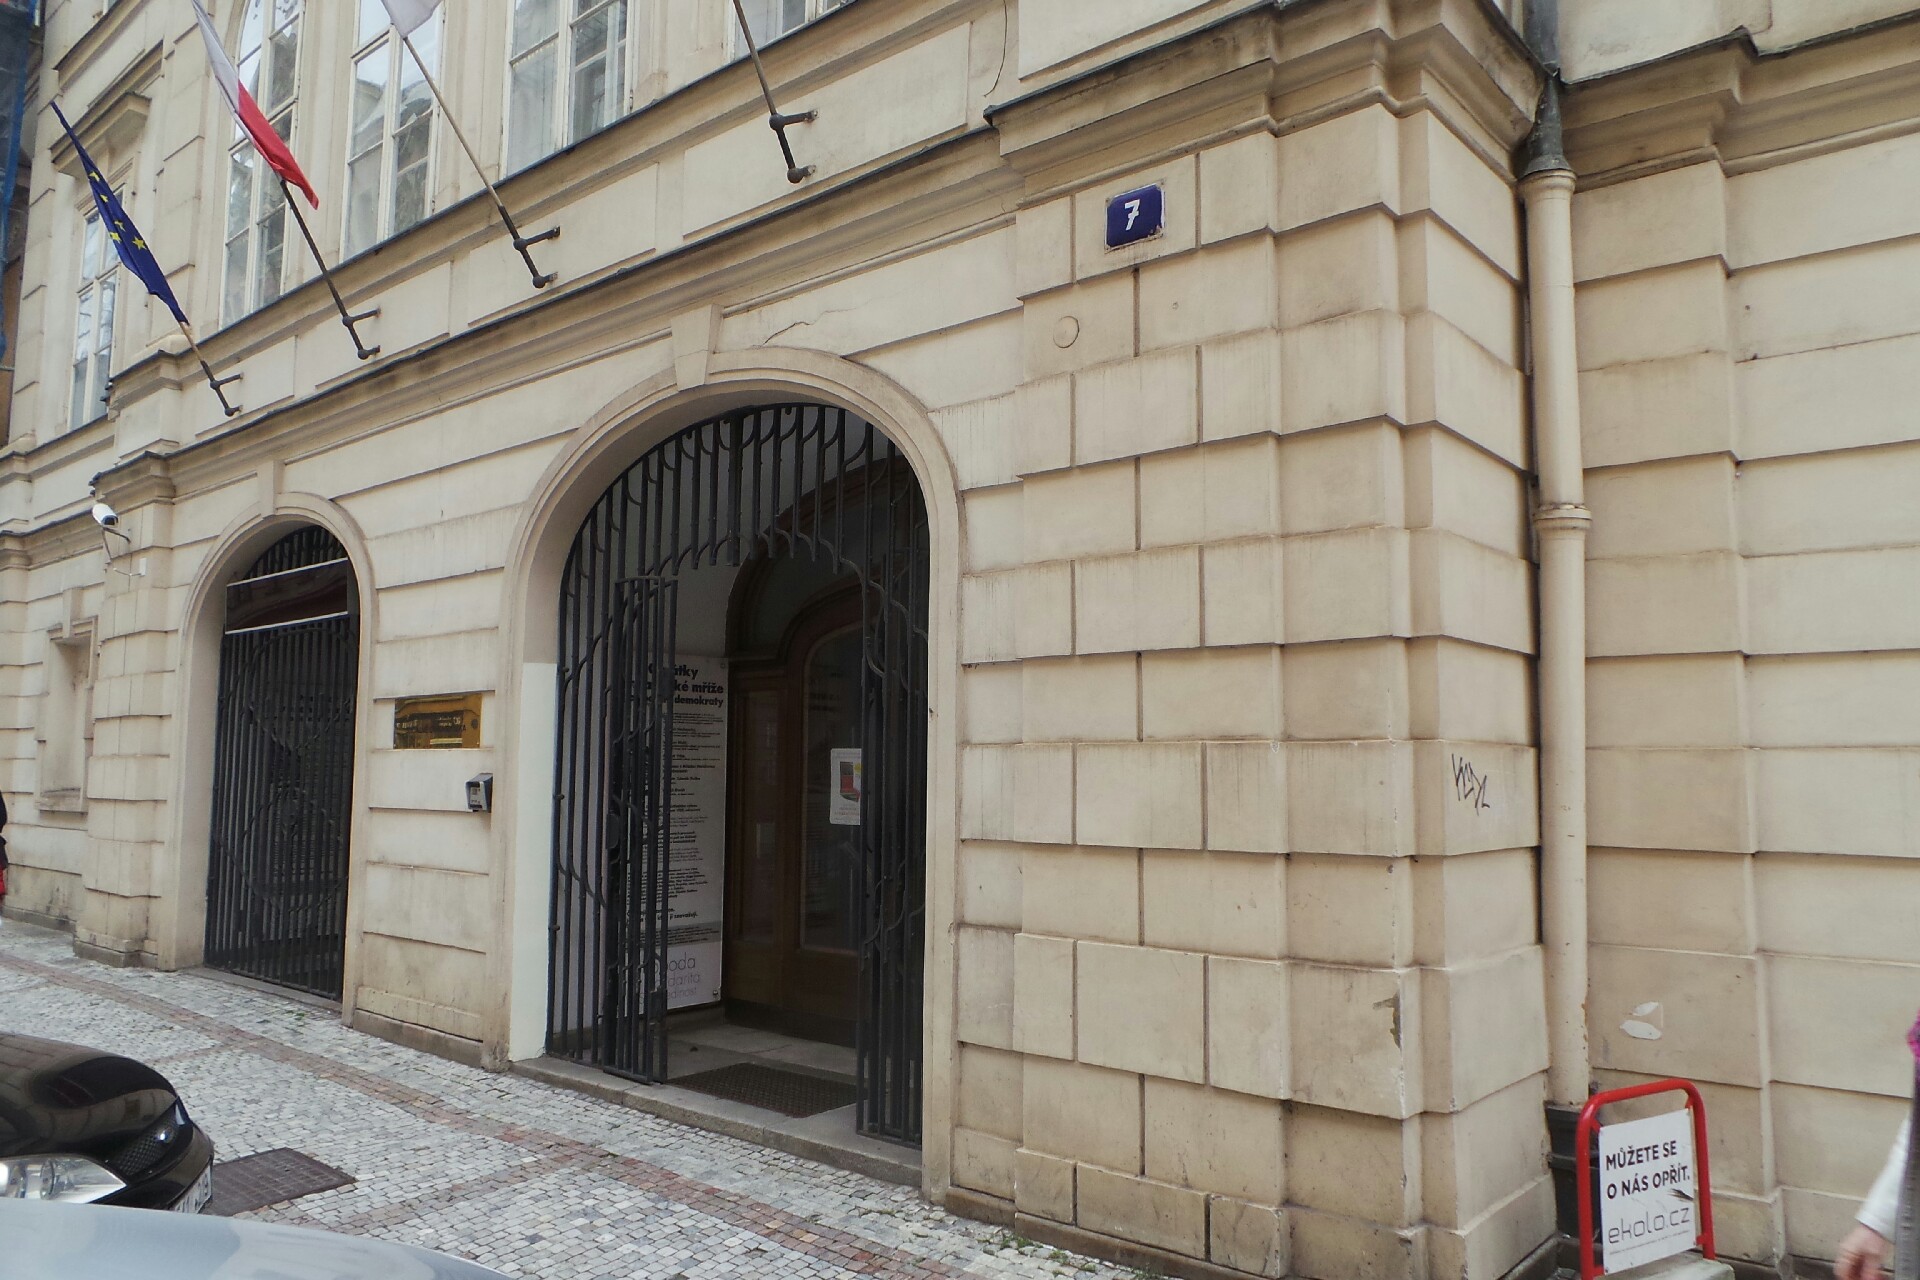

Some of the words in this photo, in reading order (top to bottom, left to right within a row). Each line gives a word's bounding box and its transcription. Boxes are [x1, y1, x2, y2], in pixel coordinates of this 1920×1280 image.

[1124, 199, 1141, 231] 7
[674, 694, 724, 708] demokraty
[1606, 1145, 1660, 1171] MŮŽETE
[1662, 1140, 1678, 1157] SE
[1606, 1183, 1618, 1200] O
[1621, 1173, 1649, 1197] NÁS
[1652, 1163, 1691, 1189] OPŘÍT.
[1608, 1207, 1690, 1244] ekolo.cz
